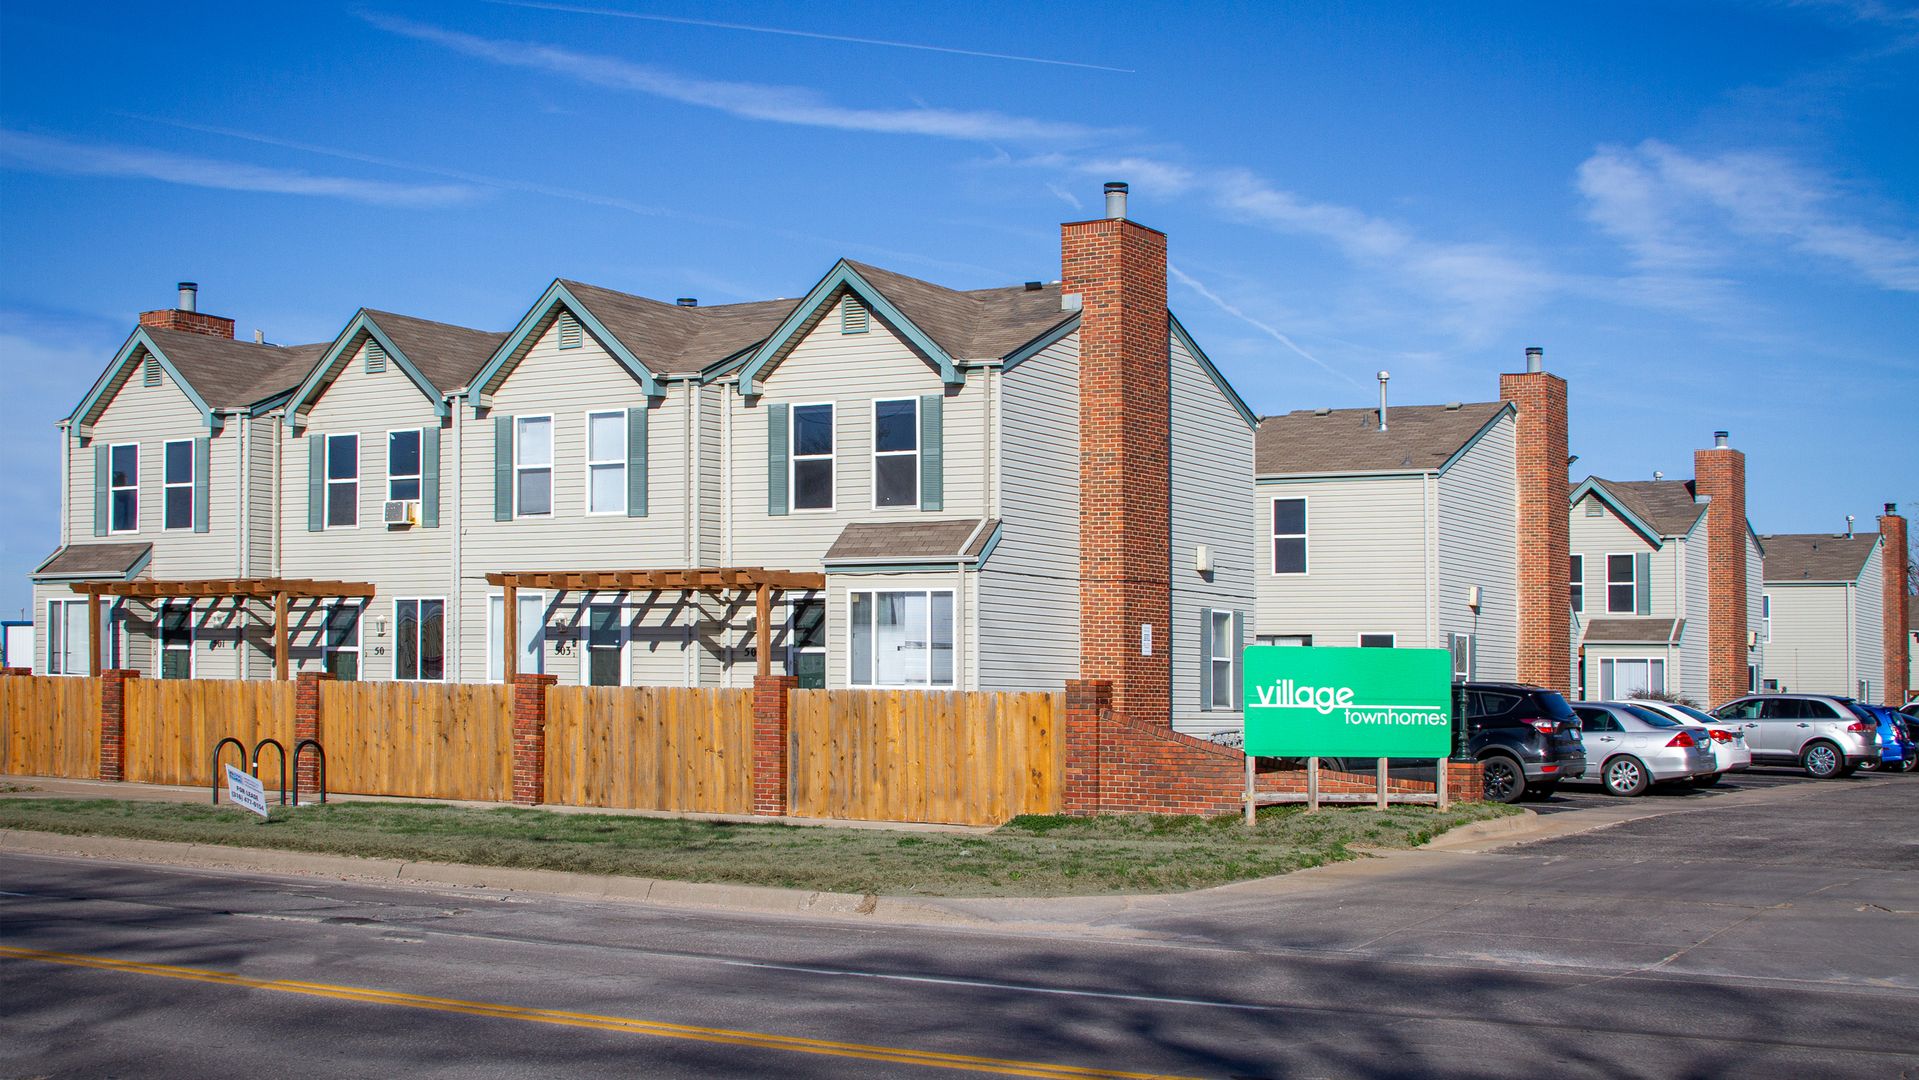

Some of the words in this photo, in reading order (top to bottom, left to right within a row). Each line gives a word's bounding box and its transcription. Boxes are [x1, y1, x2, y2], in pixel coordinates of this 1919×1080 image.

[374, 646, 385, 655] 50
[554, 646, 571, 655] 503
[1256, 679, 1355, 714] village
[1344, 708, 1448, 726] townhomes
[237, 785, 246, 795] FOR
[246, 790, 259, 801] LEASE
